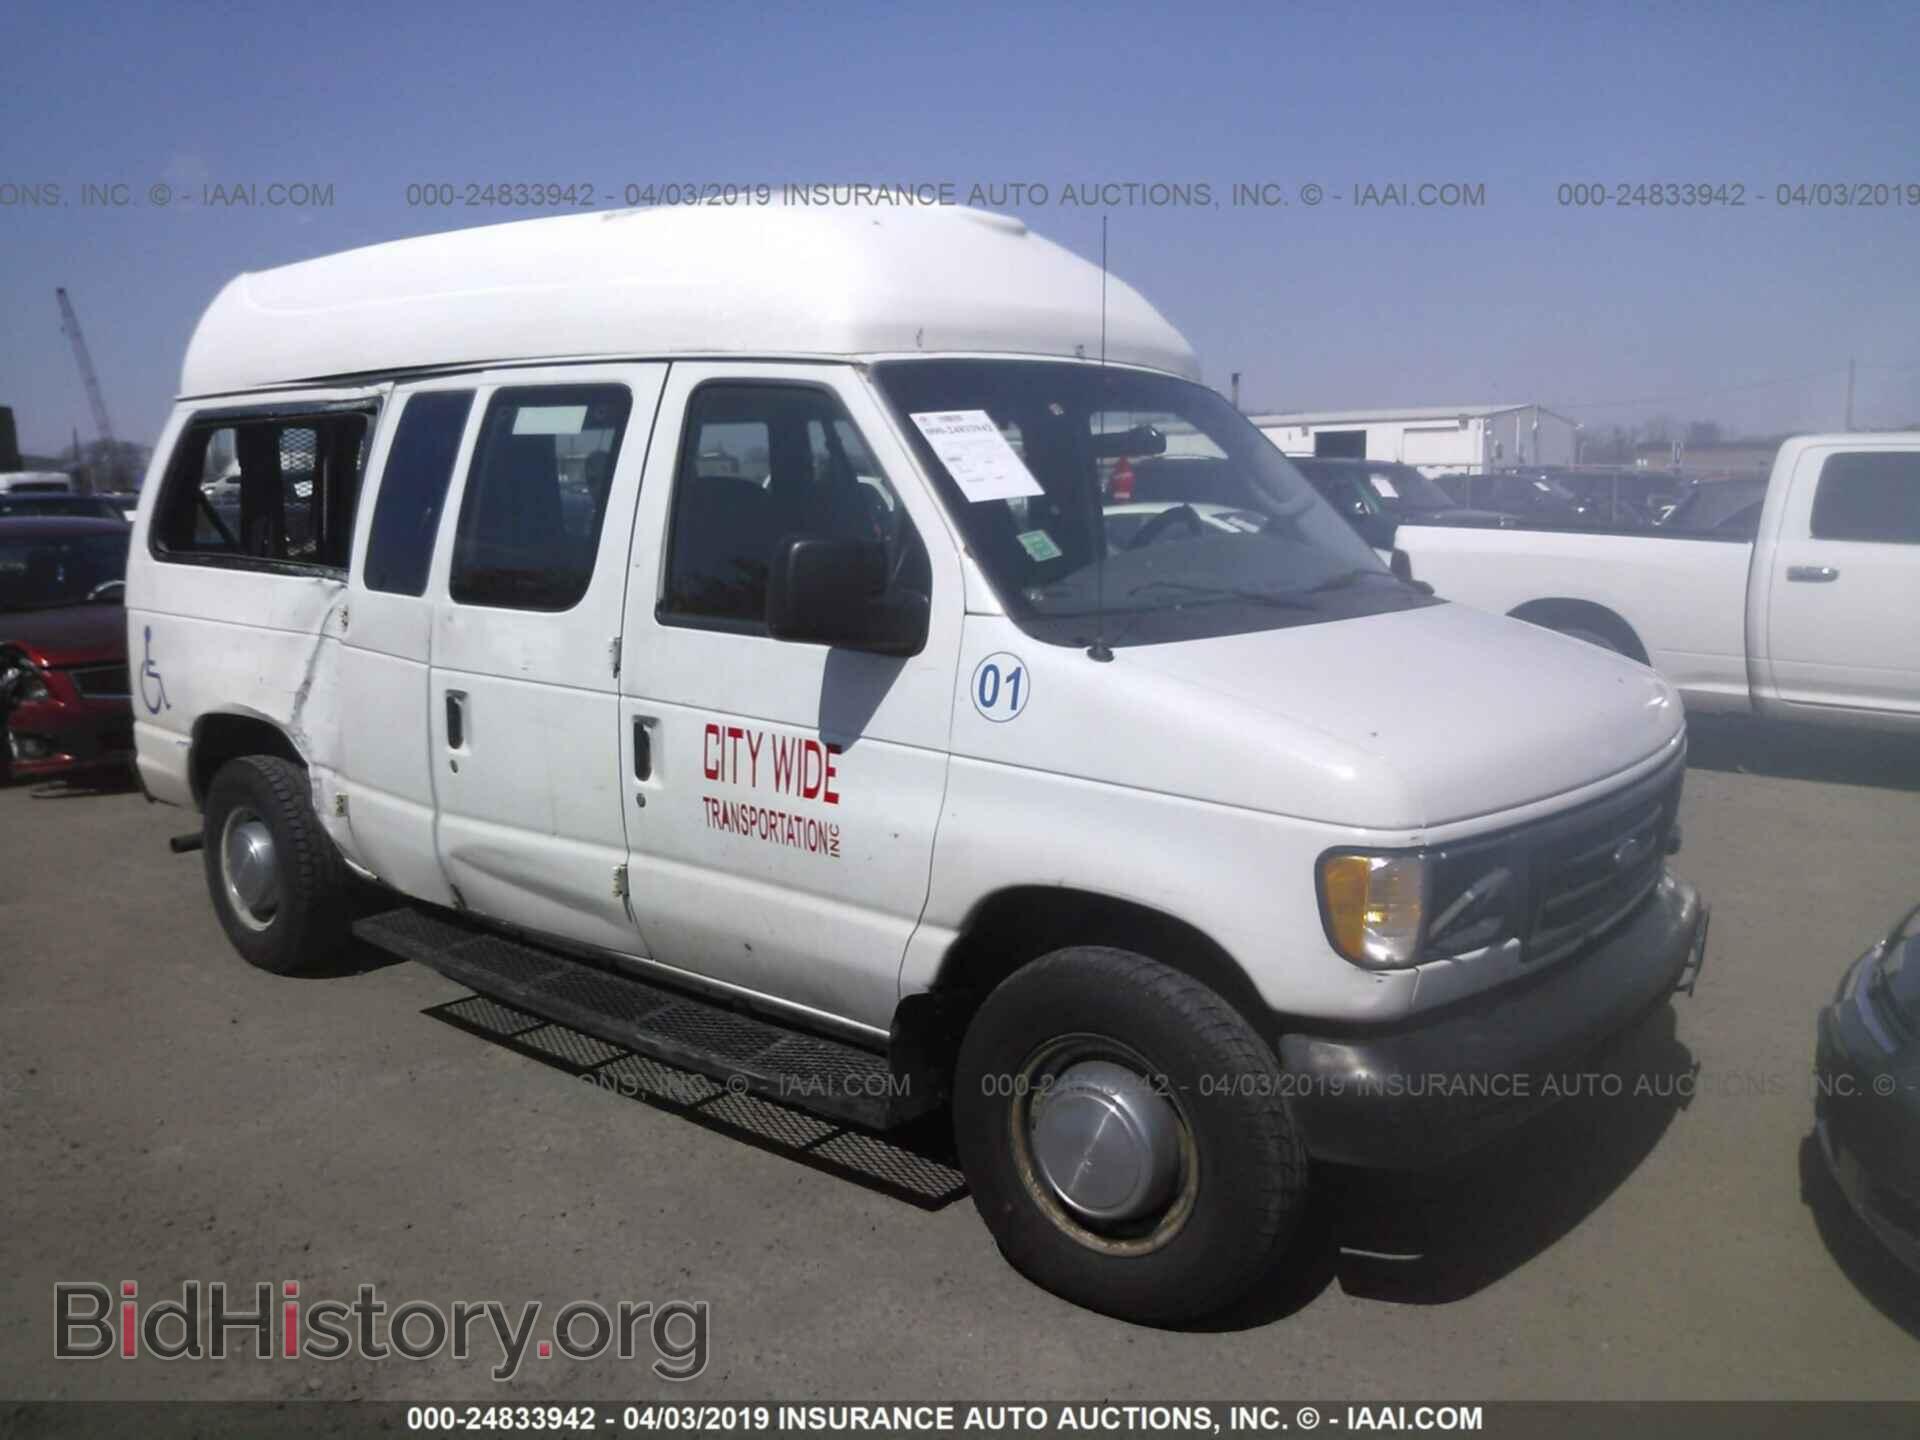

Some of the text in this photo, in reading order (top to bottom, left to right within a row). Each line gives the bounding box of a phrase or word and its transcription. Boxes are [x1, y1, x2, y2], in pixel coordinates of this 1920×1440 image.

[978, 663, 1022, 712] 01
[704, 723, 840, 804] CITY WIDE
[702, 796, 828, 856] TRANSPORTATION
[828, 824, 841, 858] INC
